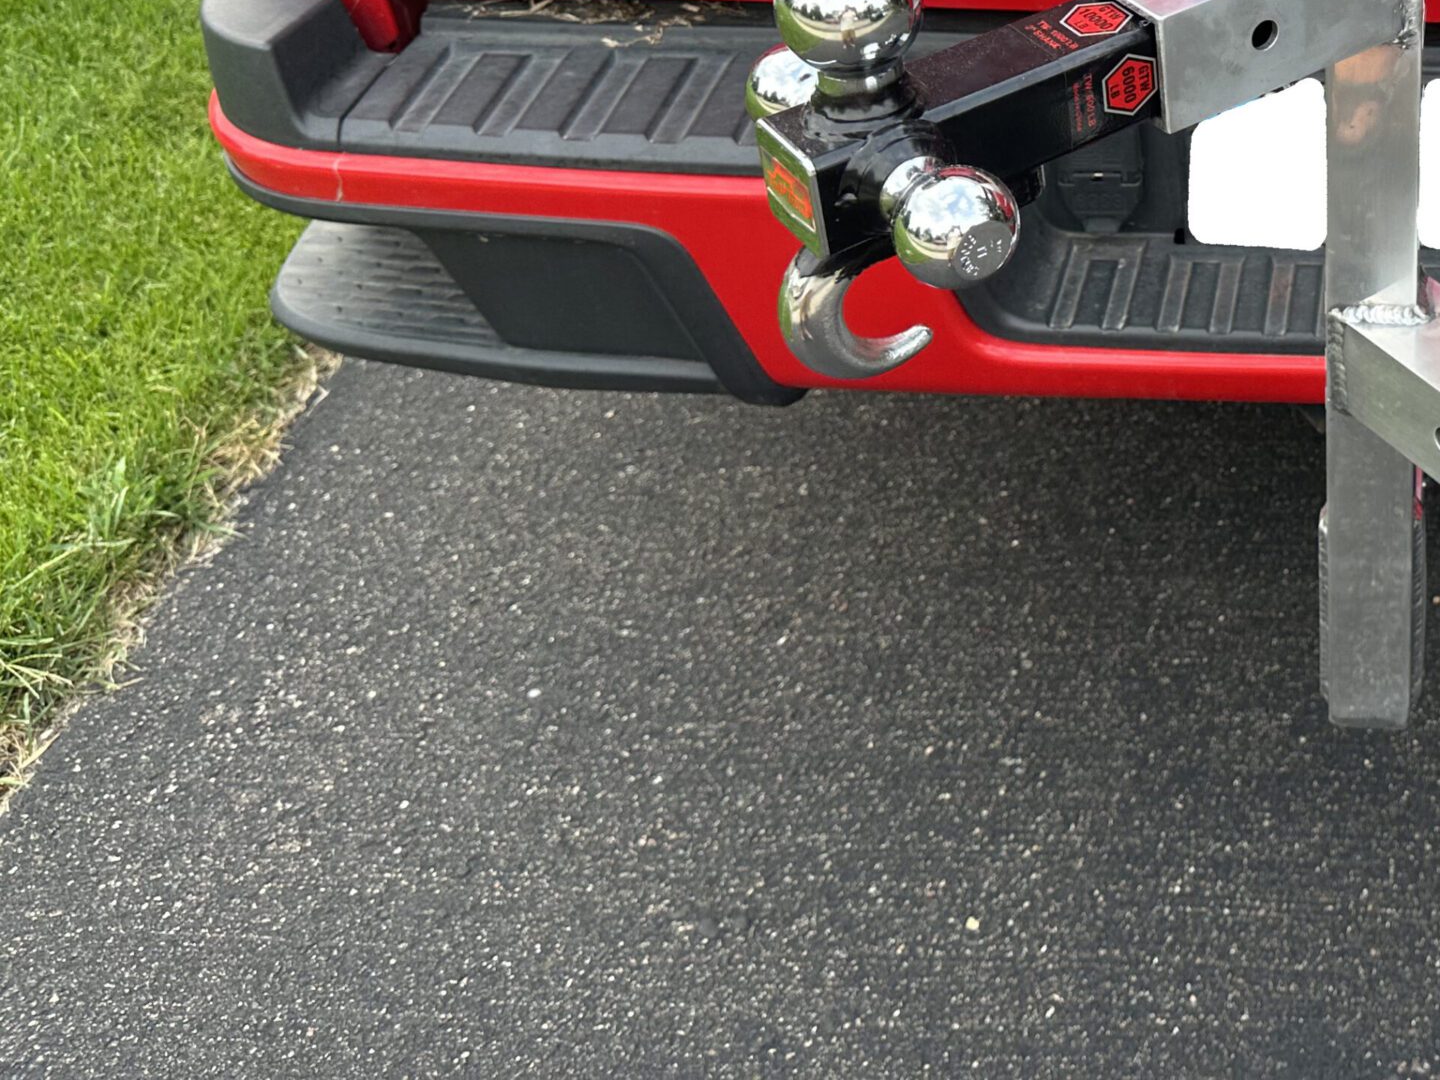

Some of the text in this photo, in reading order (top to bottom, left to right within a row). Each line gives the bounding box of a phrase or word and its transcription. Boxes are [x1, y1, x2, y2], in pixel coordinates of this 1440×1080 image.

[1080, 8, 1114, 30] 10000
[1098, 4, 1122, 20] GTW
[1073, 20, 1089, 30] LB
[1121, 65, 1137, 104] 6000
[1138, 64, 1151, 92] GTW
[1109, 83, 1121, 100] LB
